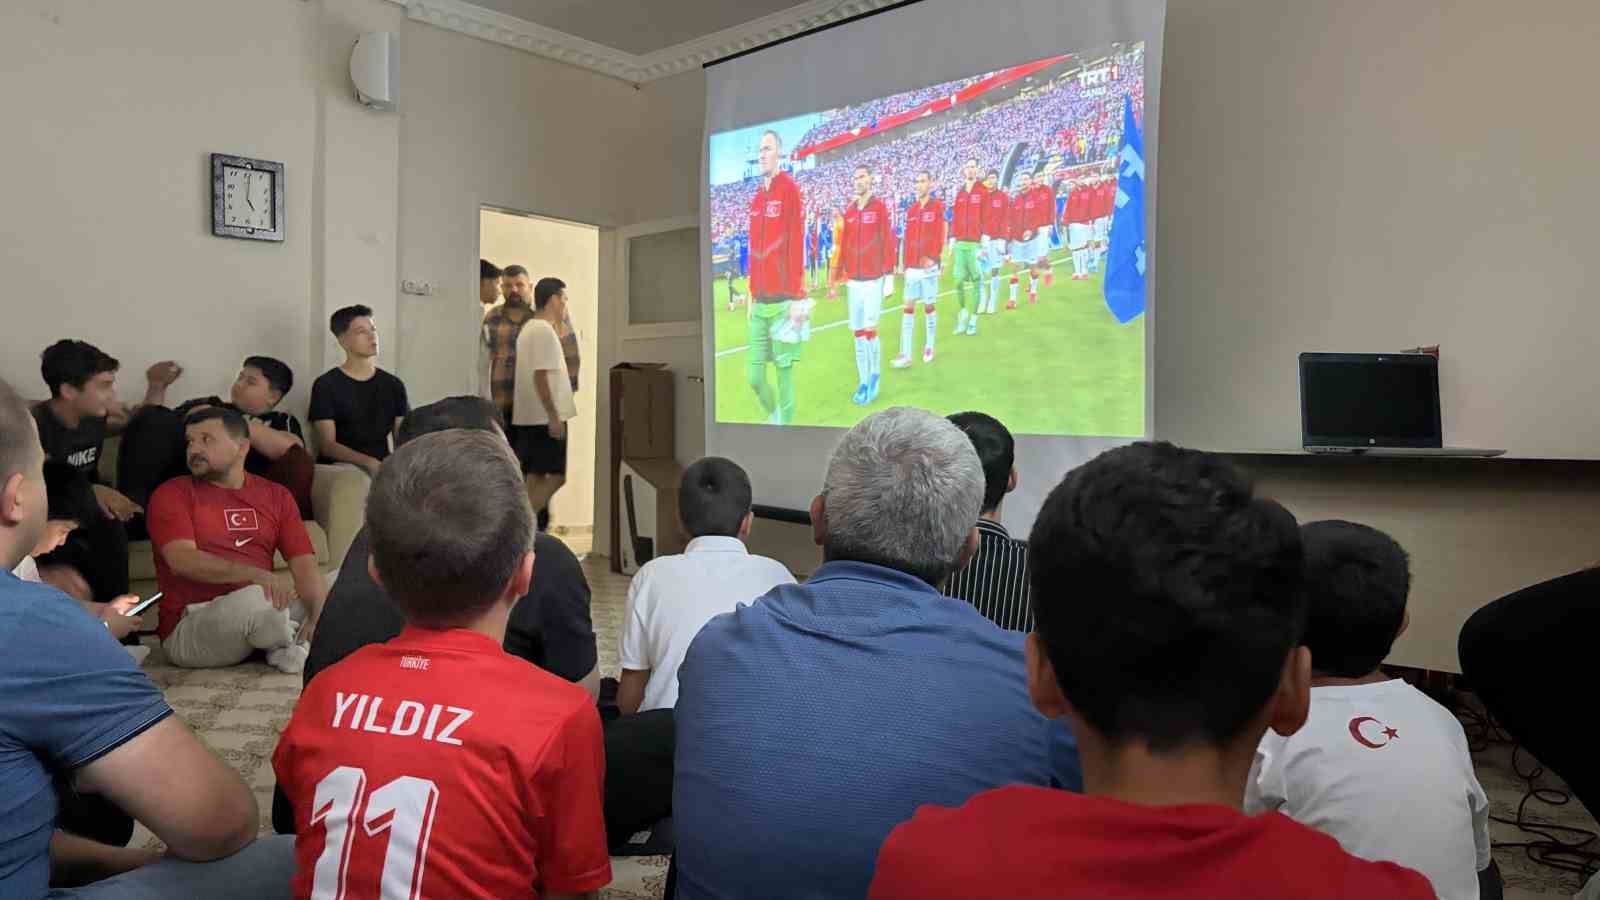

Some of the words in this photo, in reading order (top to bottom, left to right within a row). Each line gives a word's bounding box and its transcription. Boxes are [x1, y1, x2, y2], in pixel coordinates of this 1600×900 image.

[67, 447, 97, 466] NIKE
[332, 692, 473, 746] YILDIZ
[310, 766, 440, 900] 11
